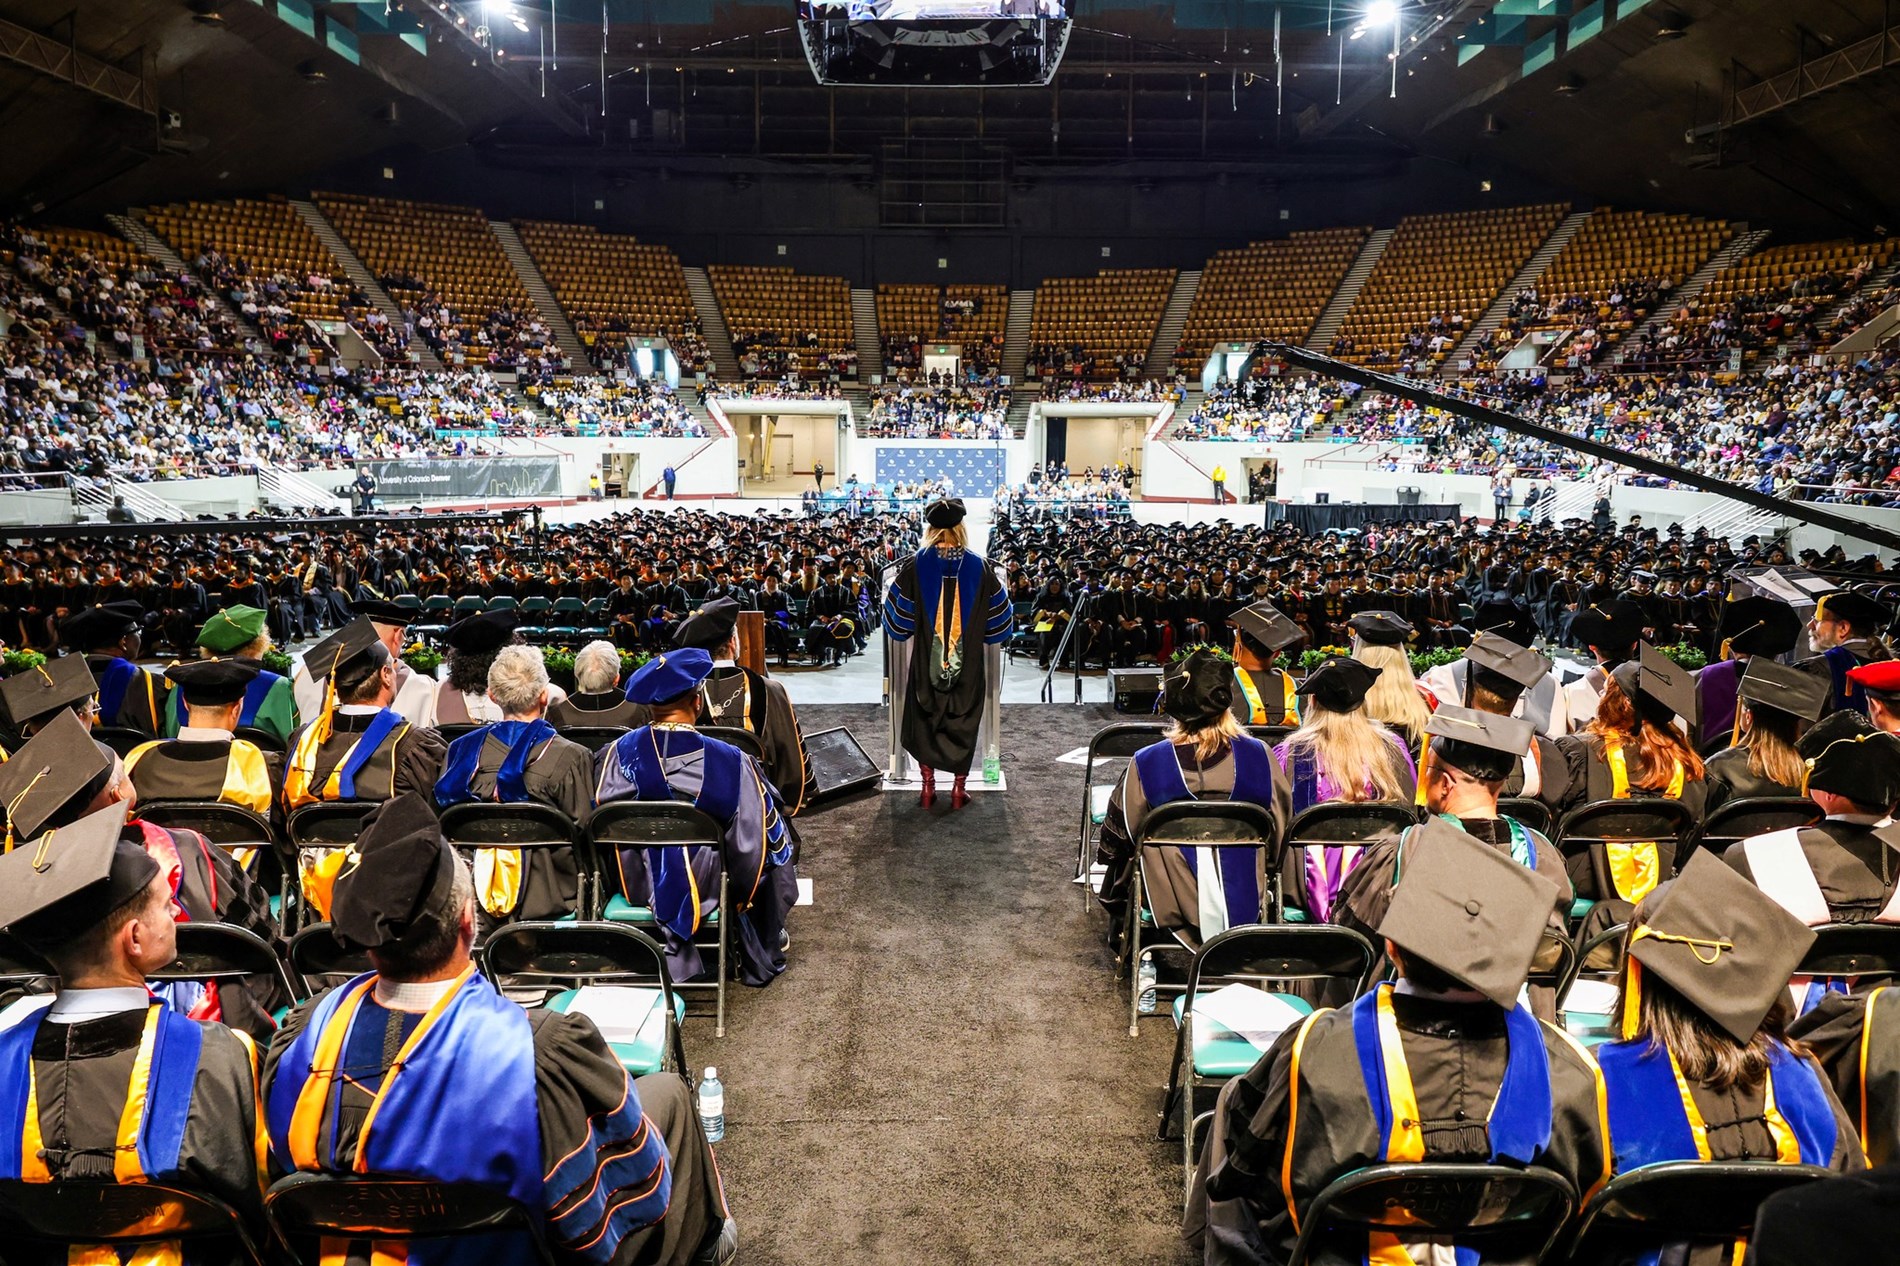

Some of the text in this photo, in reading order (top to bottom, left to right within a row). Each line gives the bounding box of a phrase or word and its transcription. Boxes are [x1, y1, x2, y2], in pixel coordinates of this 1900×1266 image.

[379, 474, 451, 485] University of Colorado Denver
